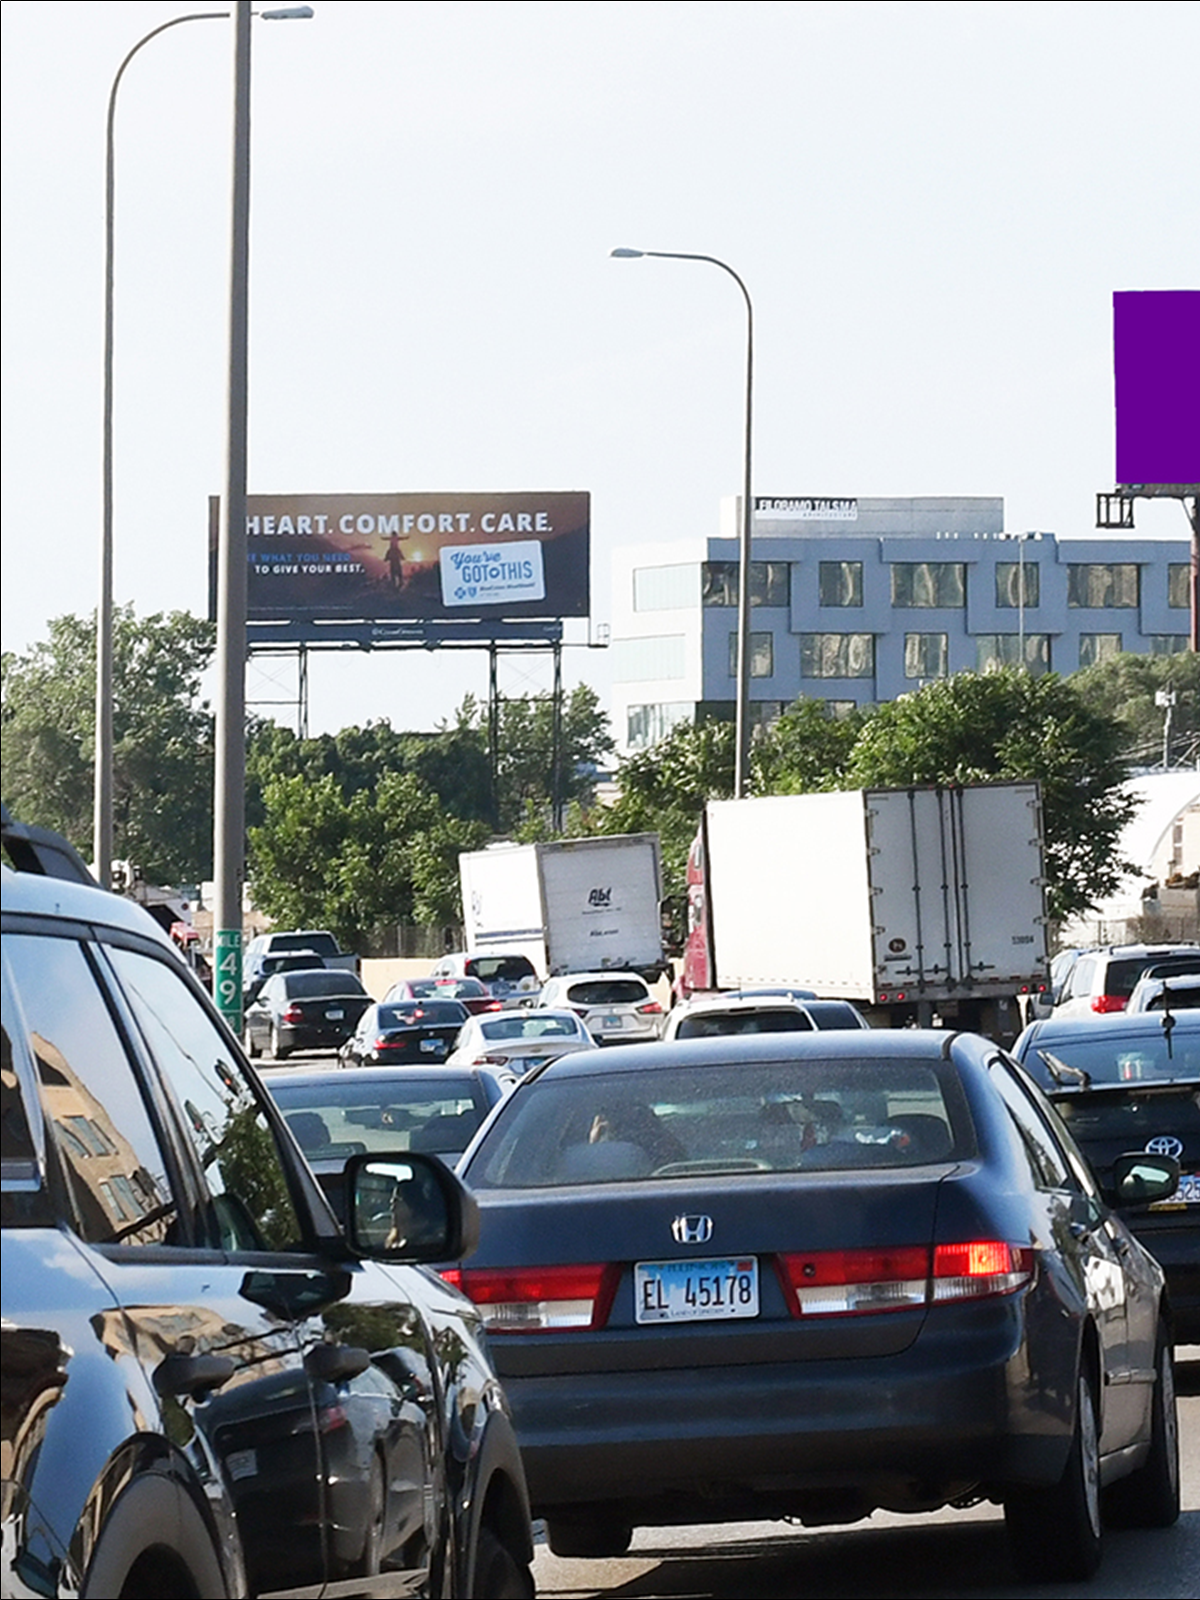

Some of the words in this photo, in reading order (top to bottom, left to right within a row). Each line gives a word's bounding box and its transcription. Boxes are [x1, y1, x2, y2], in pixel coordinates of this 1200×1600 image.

[246, 515, 333, 535] HEART.
[339, 513, 475, 534] COMFORT.
[480, 512, 553, 533] CARE.
[260, 553, 292, 562] WHAT
[298, 553, 319, 562] YOU
[450, 551, 501, 570] You've
[254, 564, 270, 574] TO
[273, 564, 299, 574] GIVE
[301, 564, 332, 574] YOUR
[335, 563, 366, 574] BEST.
[643, 1279, 669, 1311] EL
[685, 1275, 752, 1307] 45178
